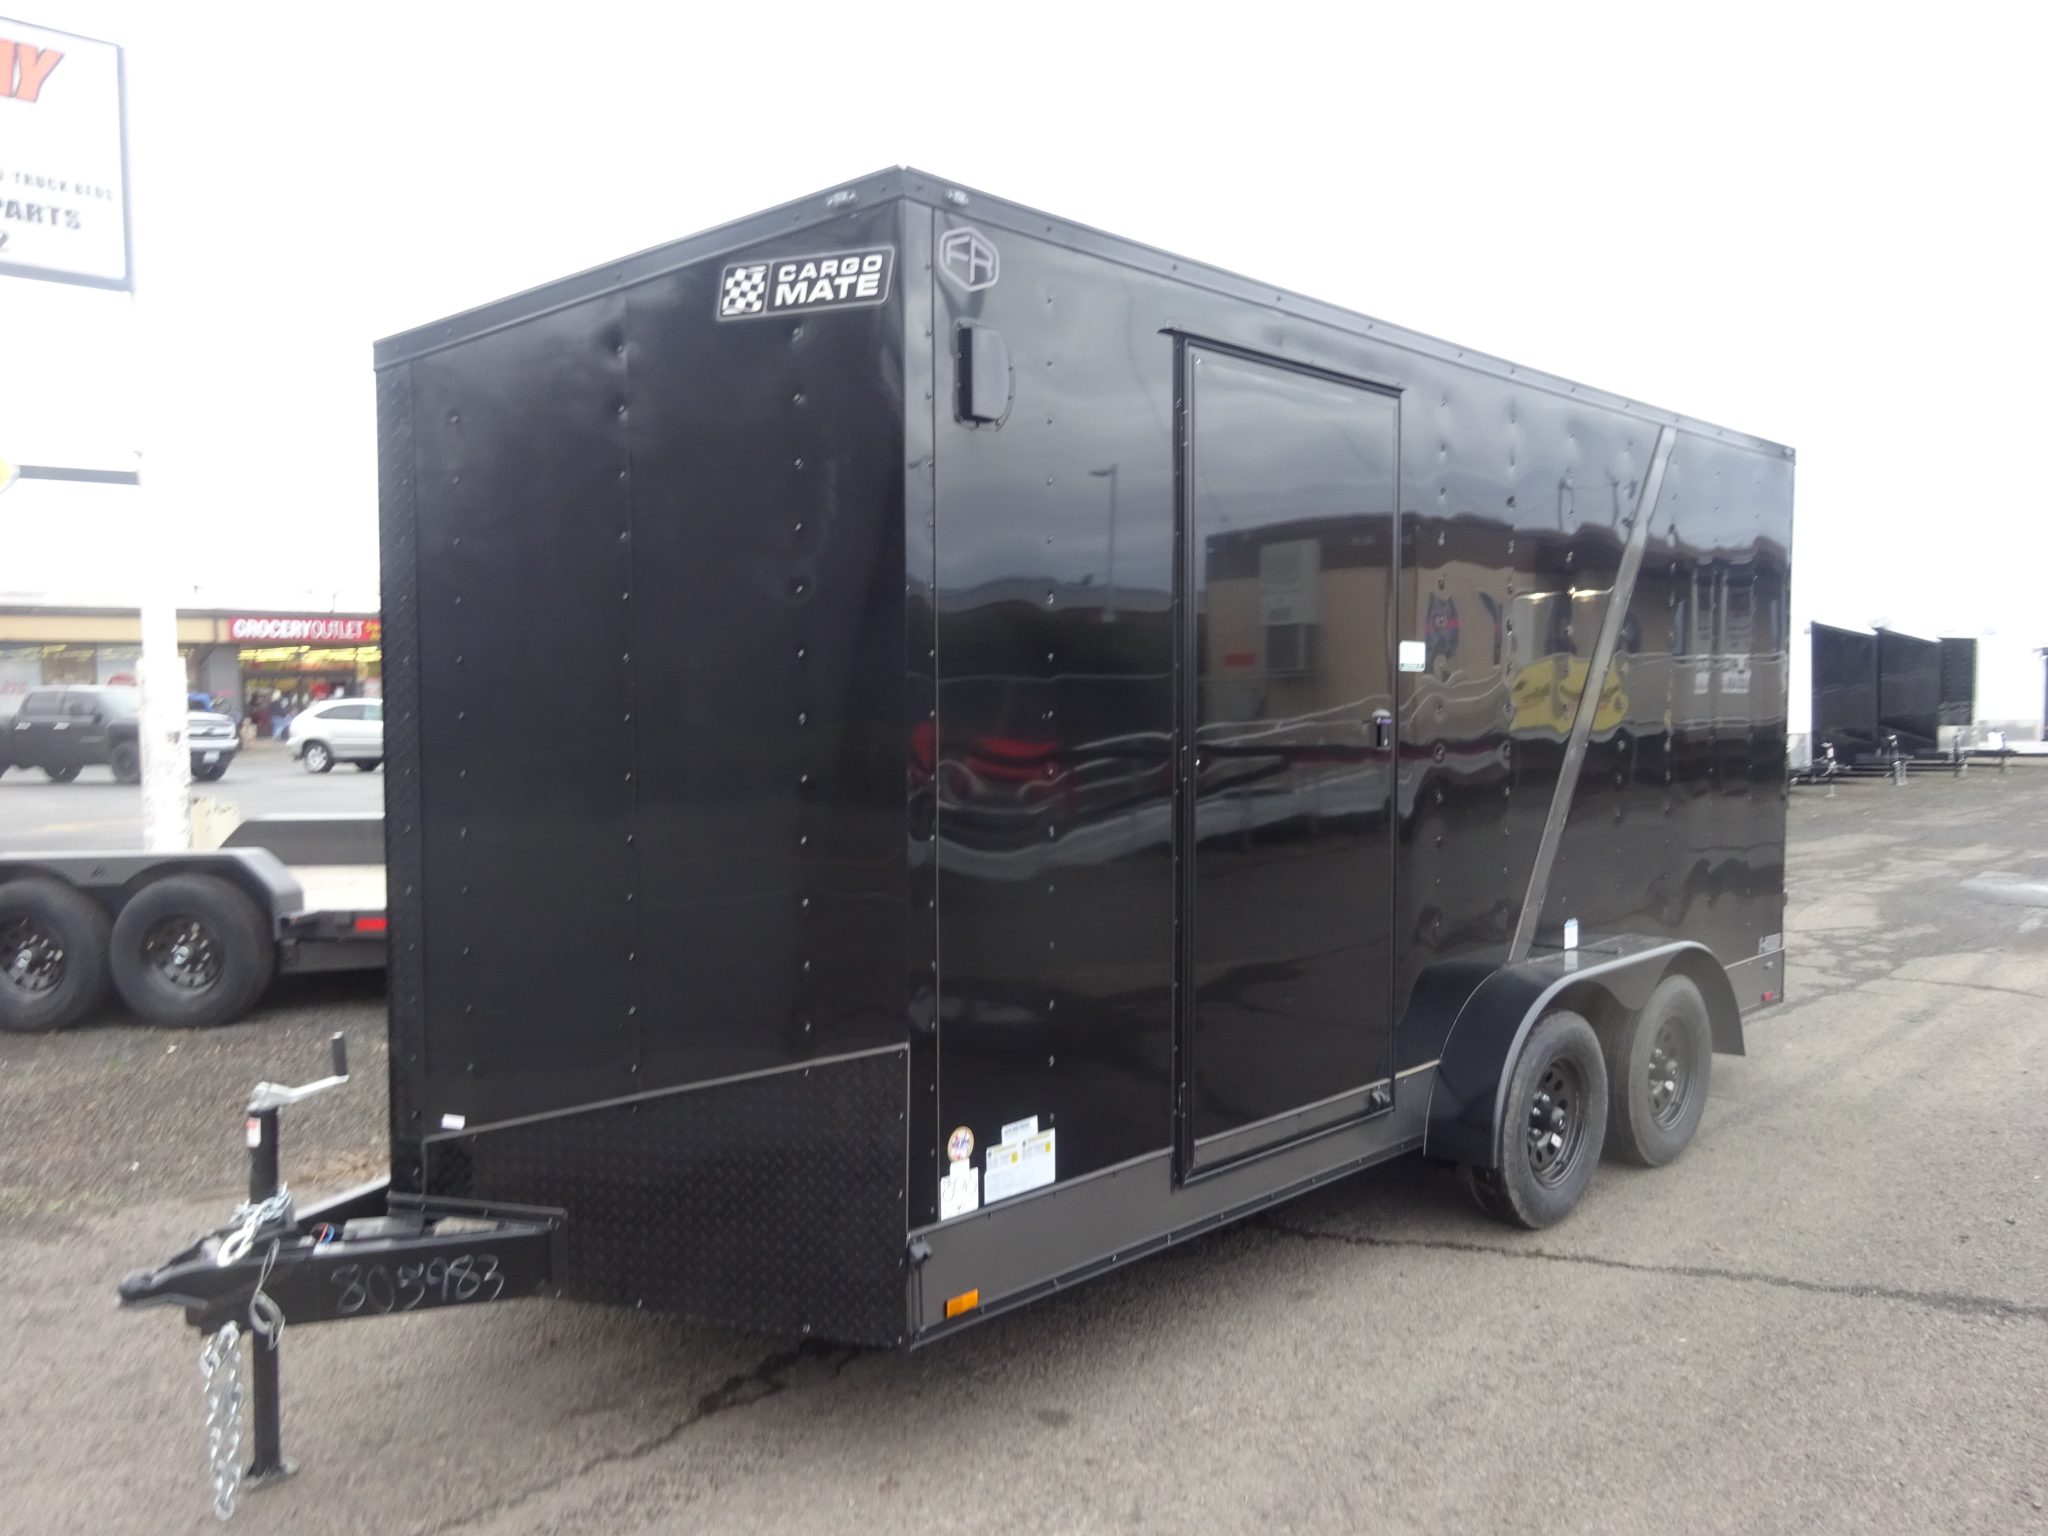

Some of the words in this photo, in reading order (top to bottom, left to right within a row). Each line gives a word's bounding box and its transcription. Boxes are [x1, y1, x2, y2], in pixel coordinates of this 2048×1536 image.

[14, 171, 69, 193] TRUCK
[0, 198, 80, 230] ARTS
[778, 254, 883, 282] CARGO
[774, 272, 880, 307] MATE
